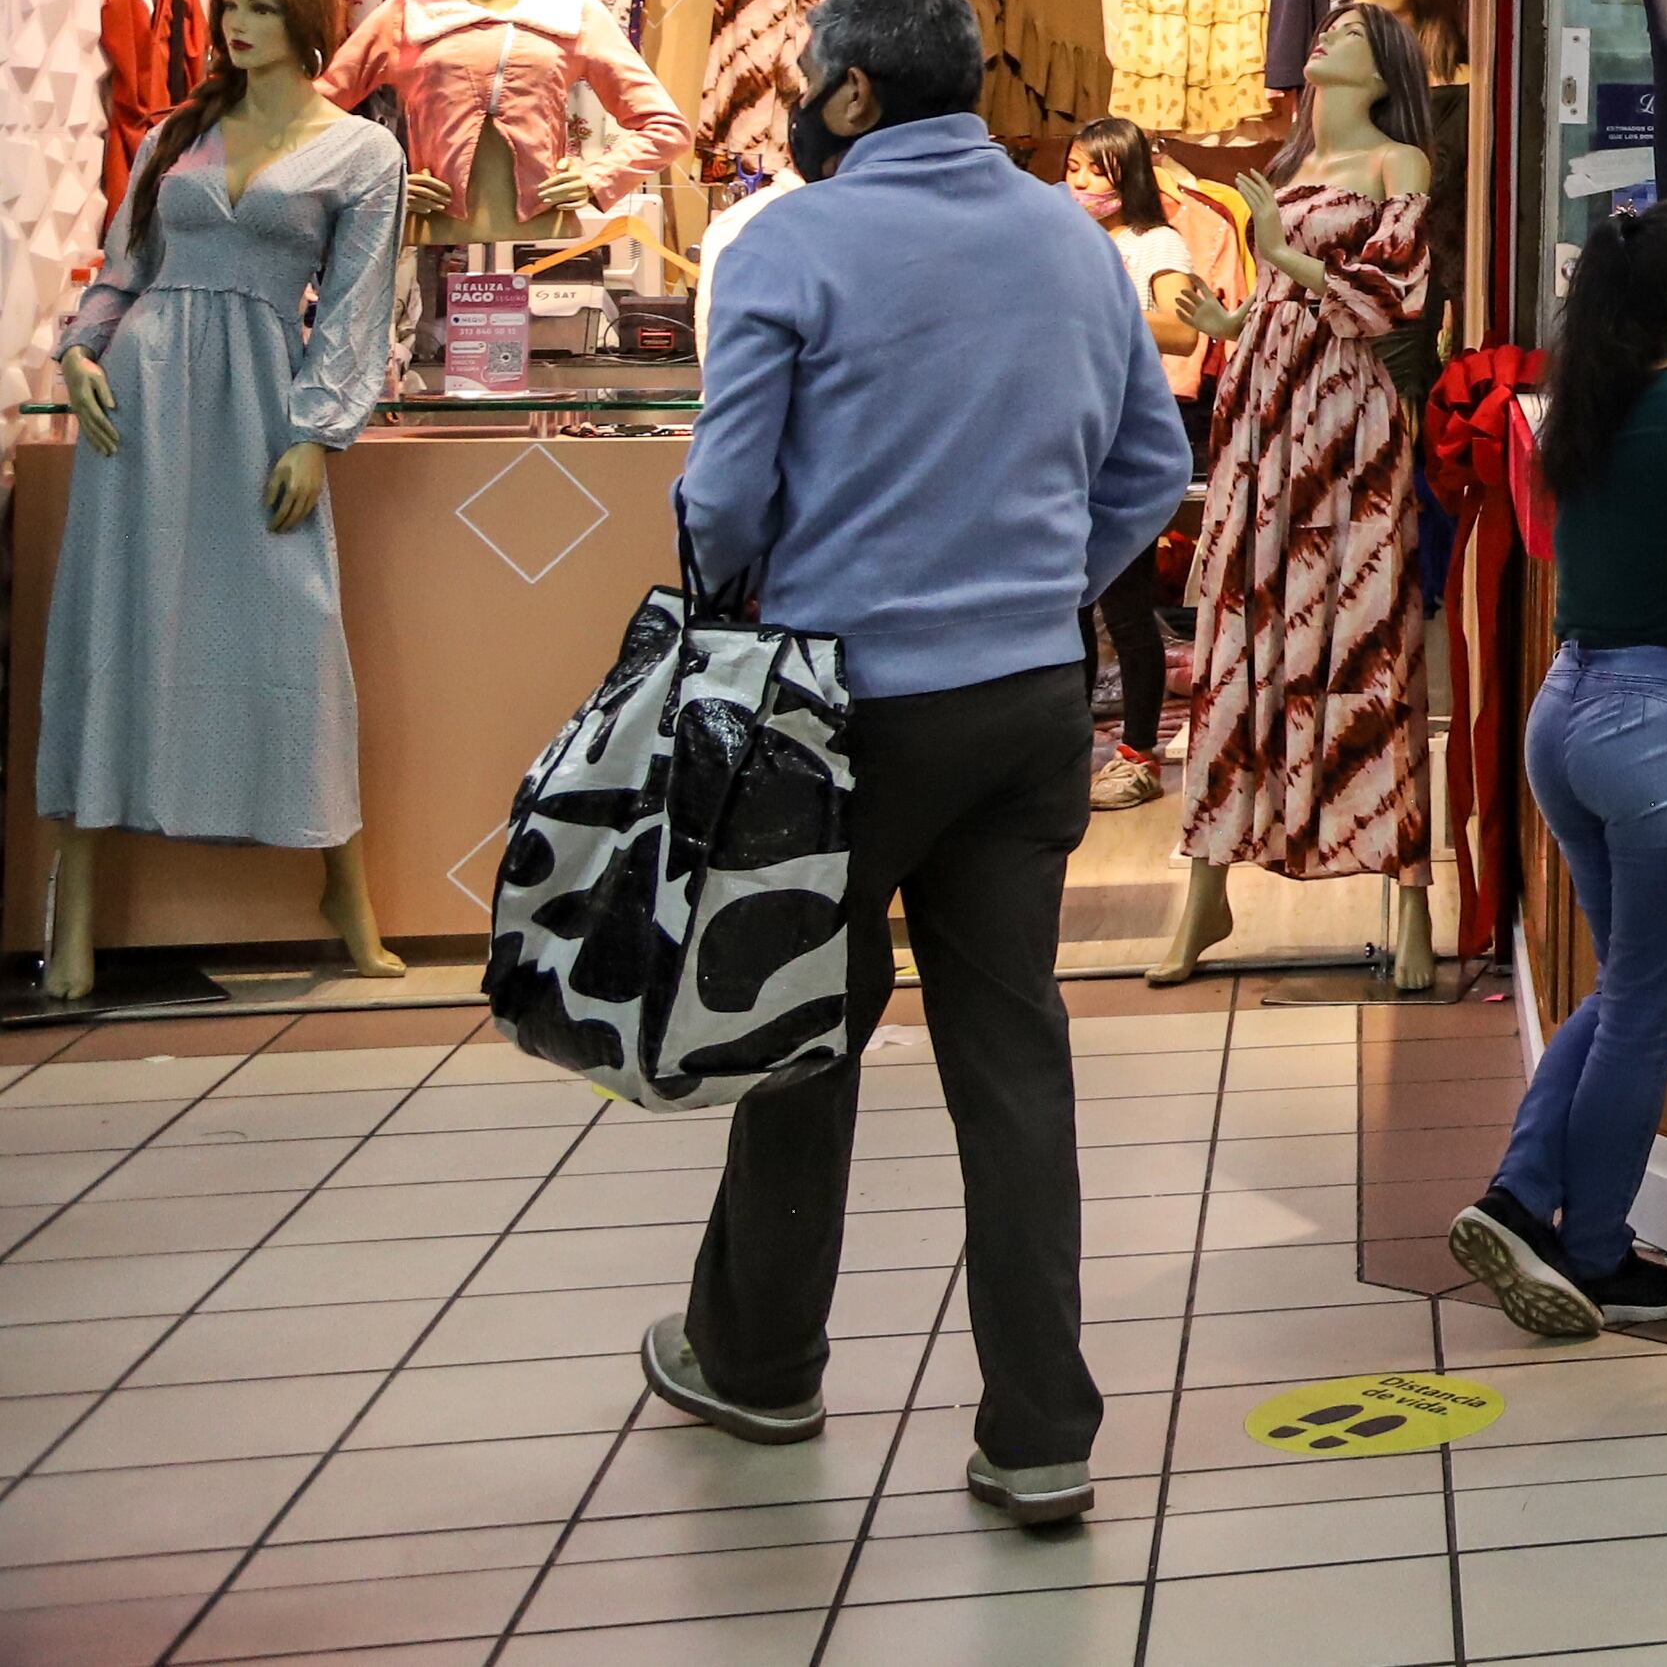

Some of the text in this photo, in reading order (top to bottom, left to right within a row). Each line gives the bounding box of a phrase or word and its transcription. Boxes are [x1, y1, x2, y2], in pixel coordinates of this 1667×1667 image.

[450, 292, 495, 303] PAGO
[553, 291, 577, 300] SAT
[1378, 1376, 1487, 1408] Distancia
[1361, 1388, 1449, 1416] de vida.
